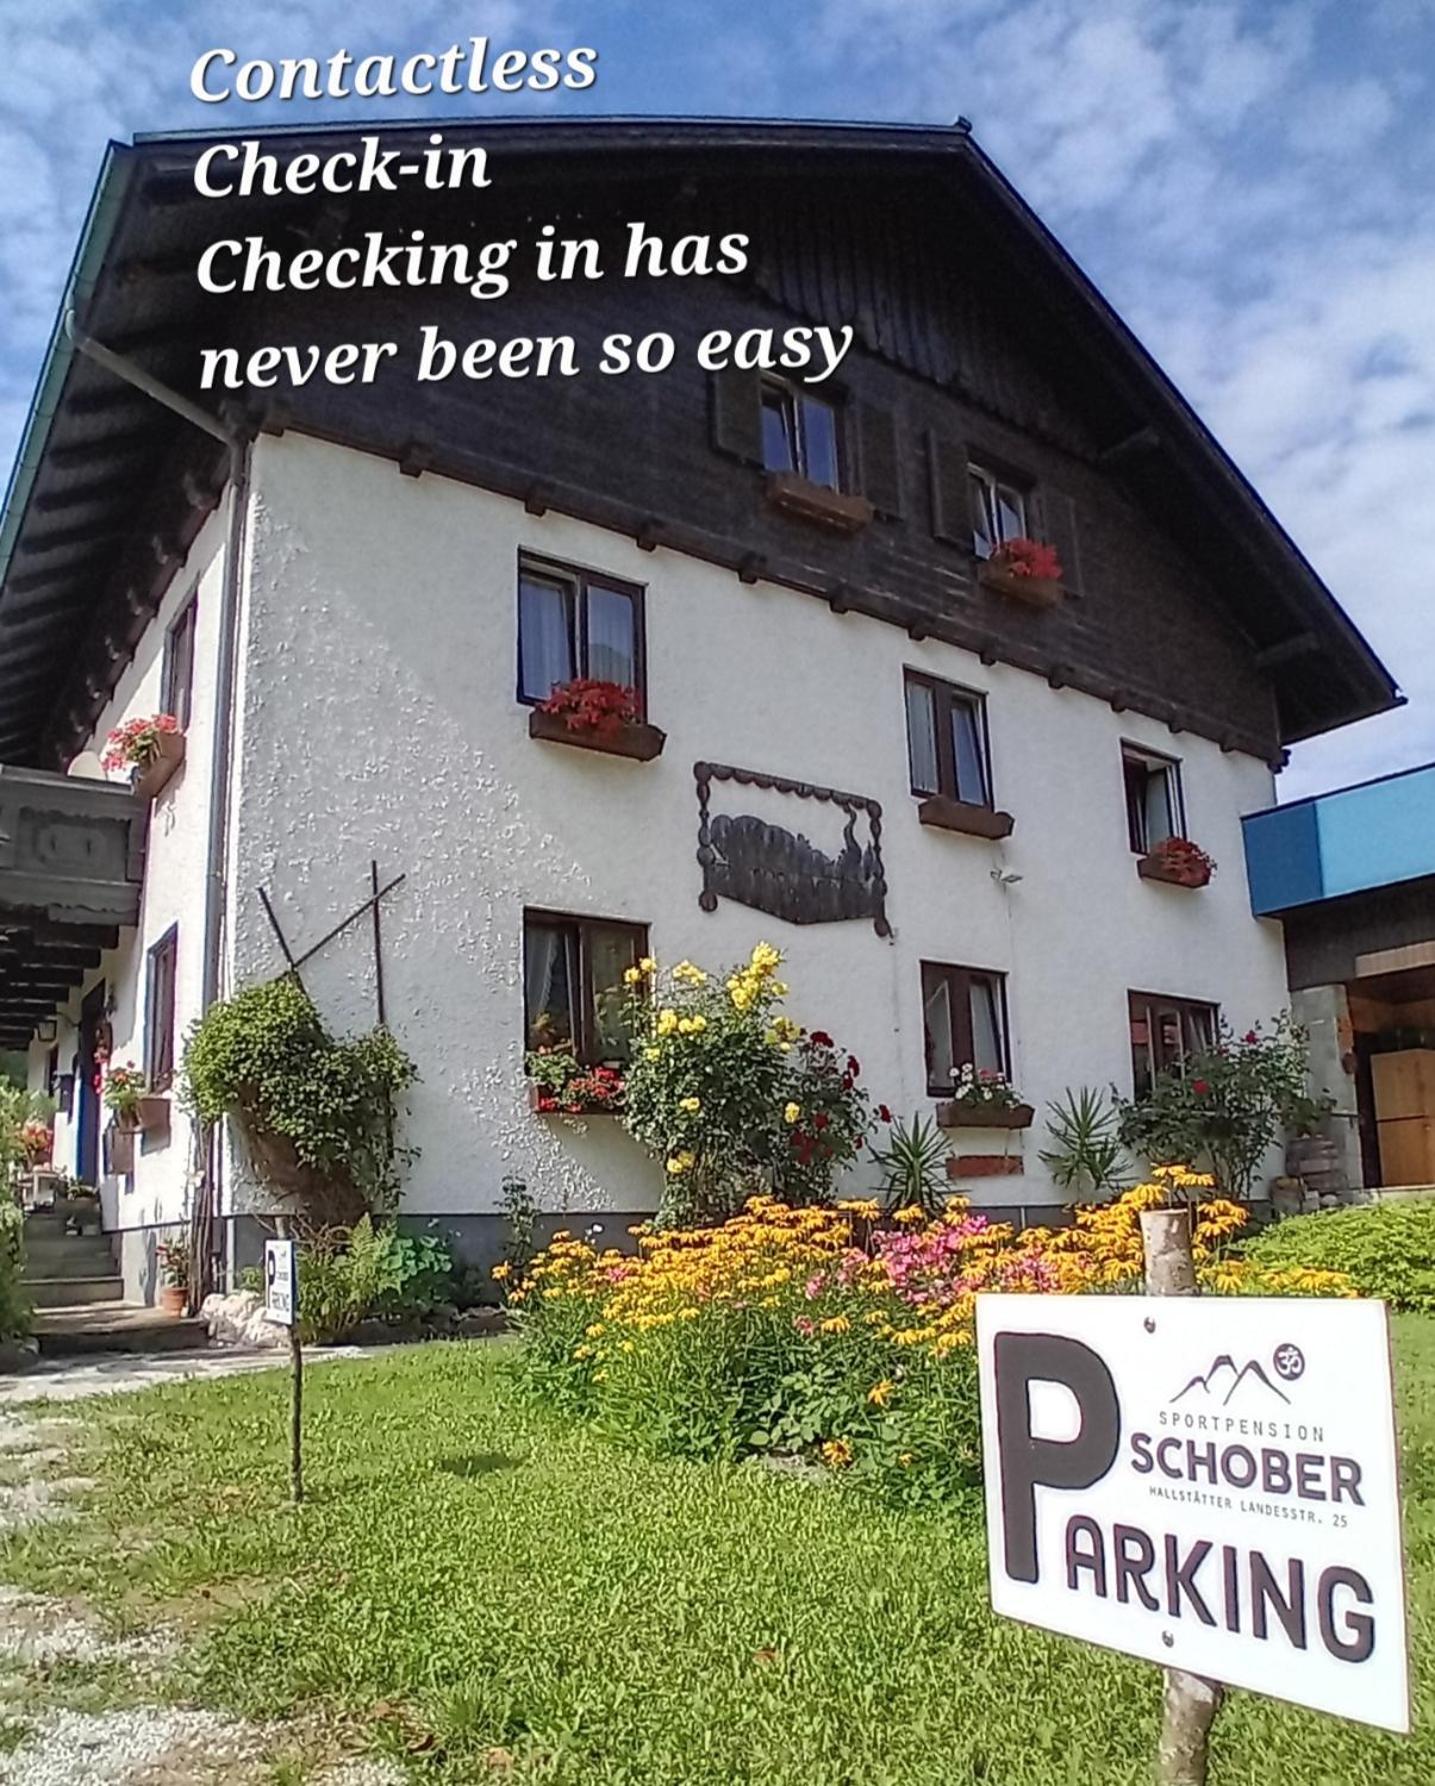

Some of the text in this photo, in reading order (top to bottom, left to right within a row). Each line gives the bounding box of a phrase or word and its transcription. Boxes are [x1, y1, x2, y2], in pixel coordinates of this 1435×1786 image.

[1159, 1411, 1325, 1442] SPORTPENSION
[1130, 1432, 1366, 1506] SCHOBER
[1149, 1486, 1349, 1528] HALLSTÄTTER LANDESSTR. 25
